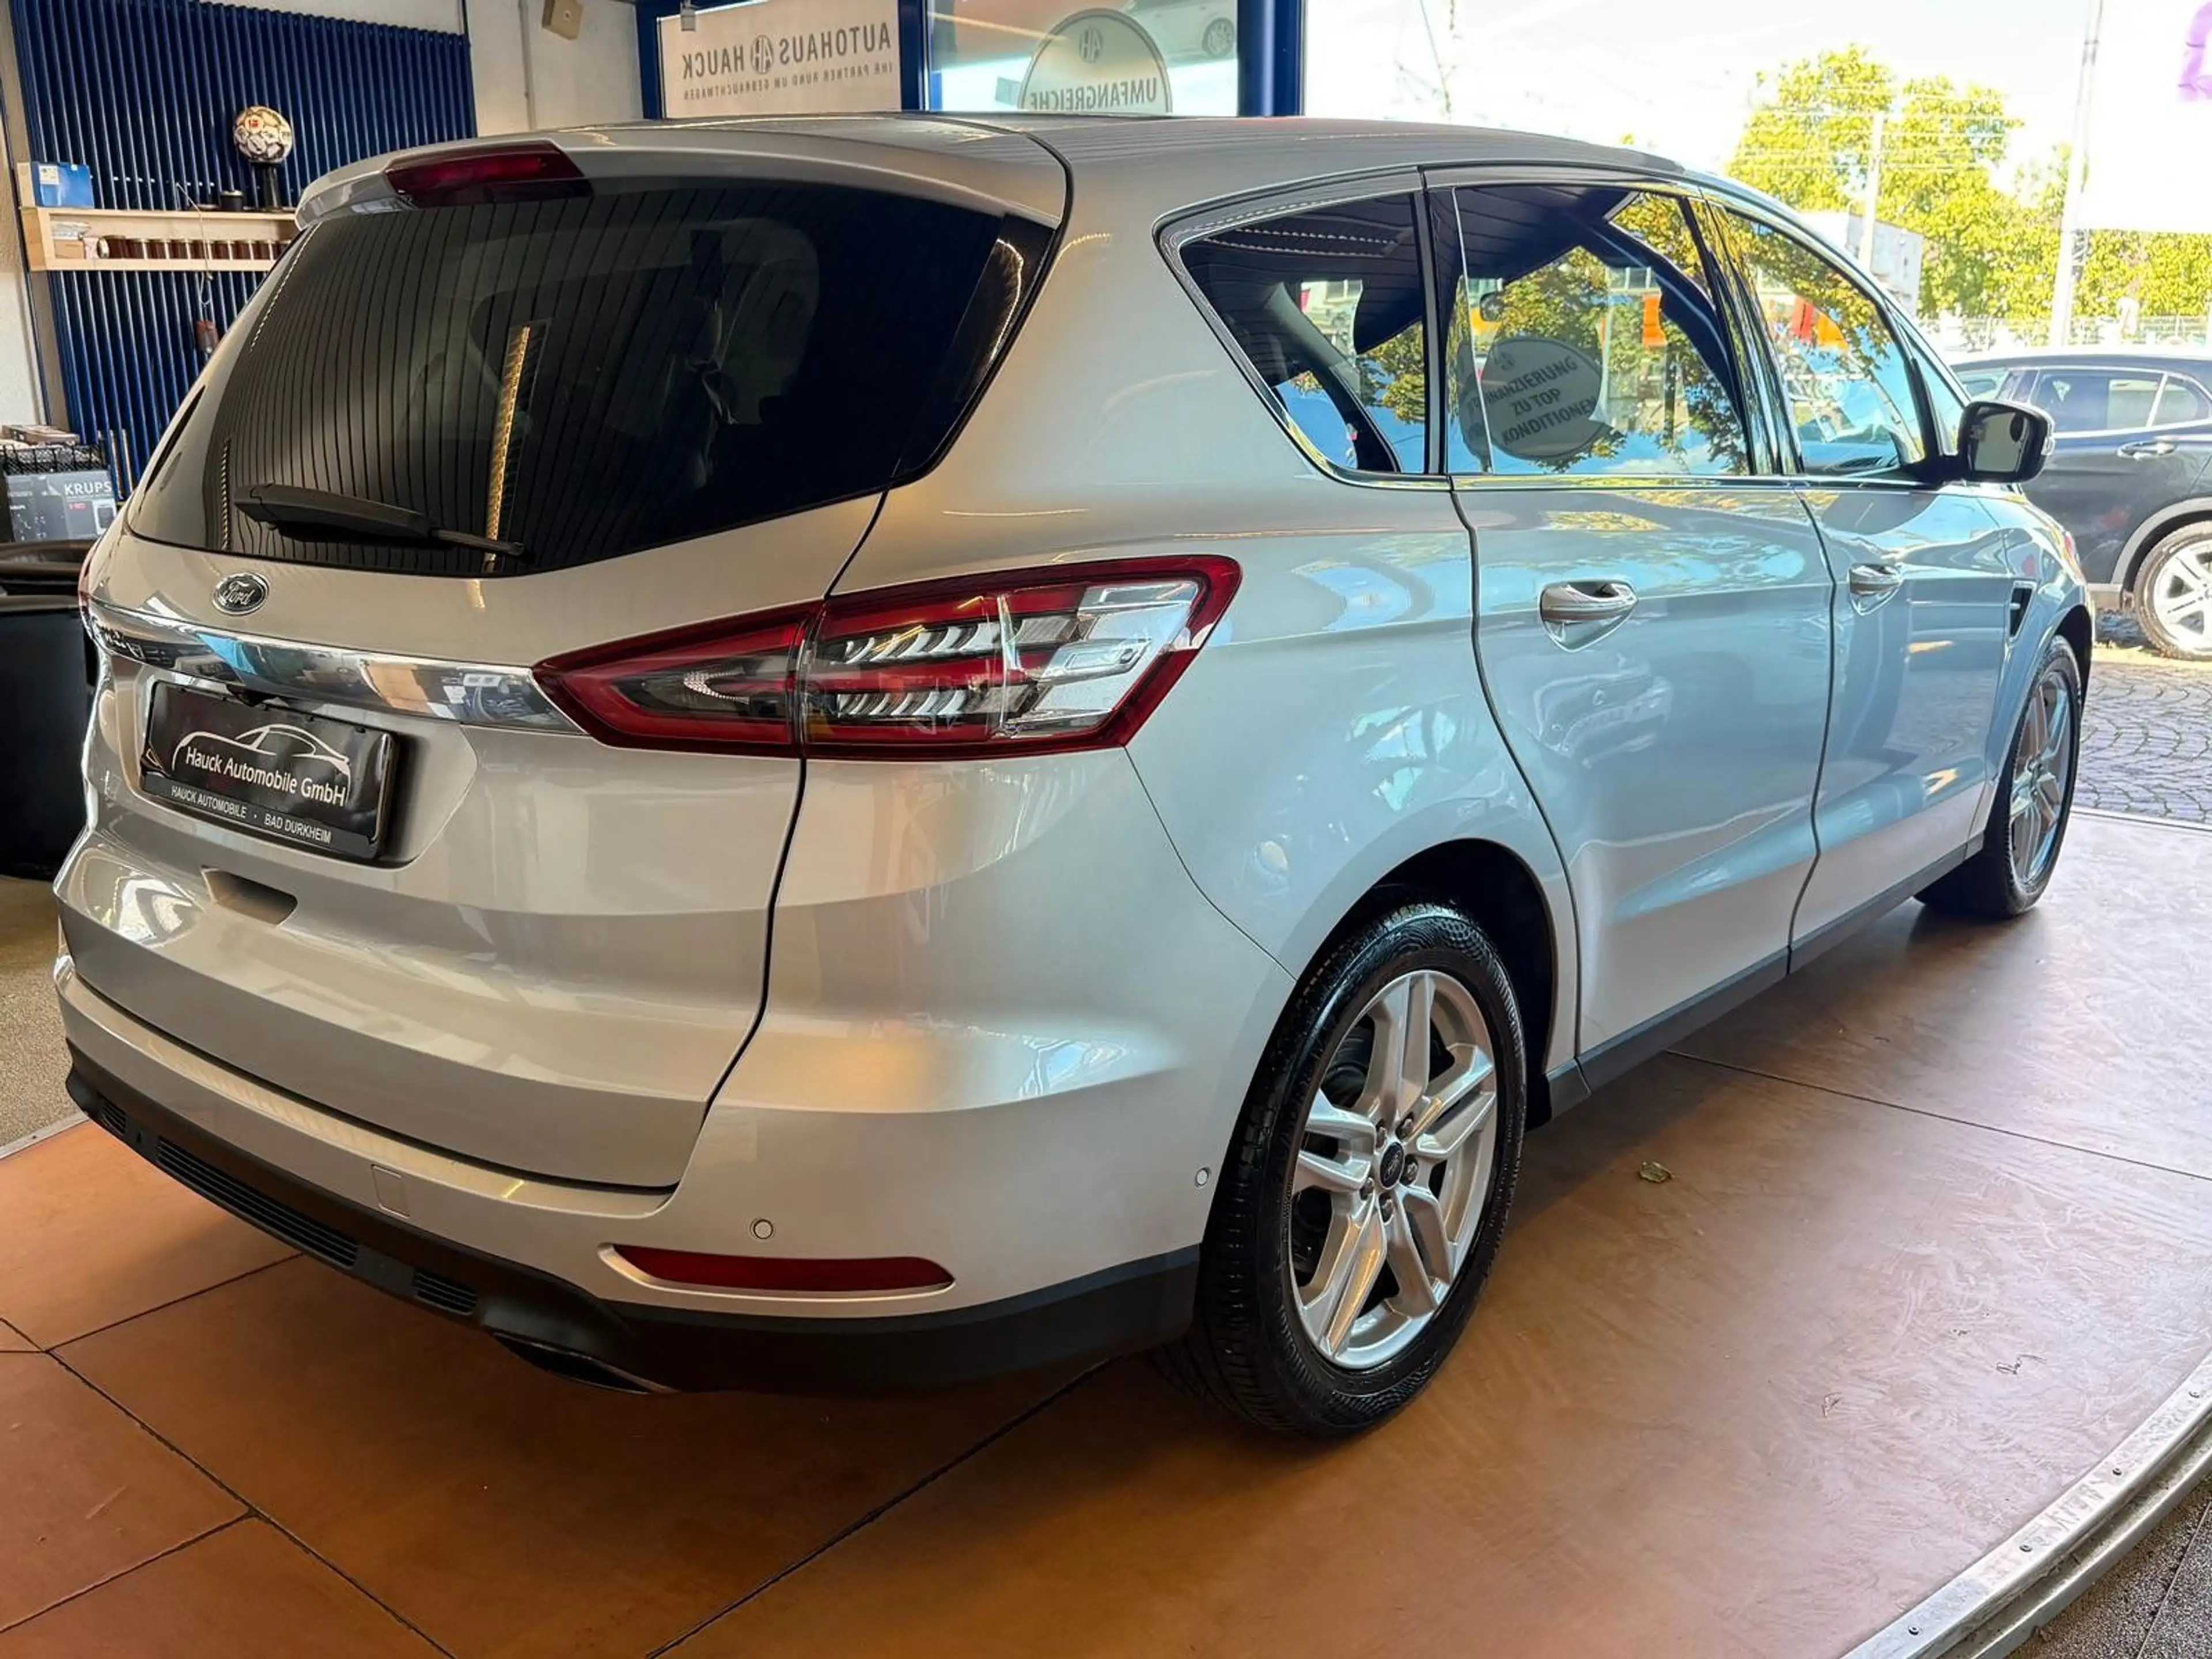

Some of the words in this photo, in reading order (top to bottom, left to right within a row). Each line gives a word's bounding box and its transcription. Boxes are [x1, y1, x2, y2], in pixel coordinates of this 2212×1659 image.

[1512, 392, 1532, 416] ZU
[1529, 388, 1561, 408] TOP
[64, 481, 112, 497] KRUPS
[222, 580, 256, 605] Ford
[185, 747, 222, 774] Hauck
[223, 757, 297, 794] Automobile
[301, 777, 346, 807] GmbH
[171, 785, 197, 804] HAUCK
[197, 793, 247, 819] AUTOMOBILE
[264, 813, 283, 830] BAD
